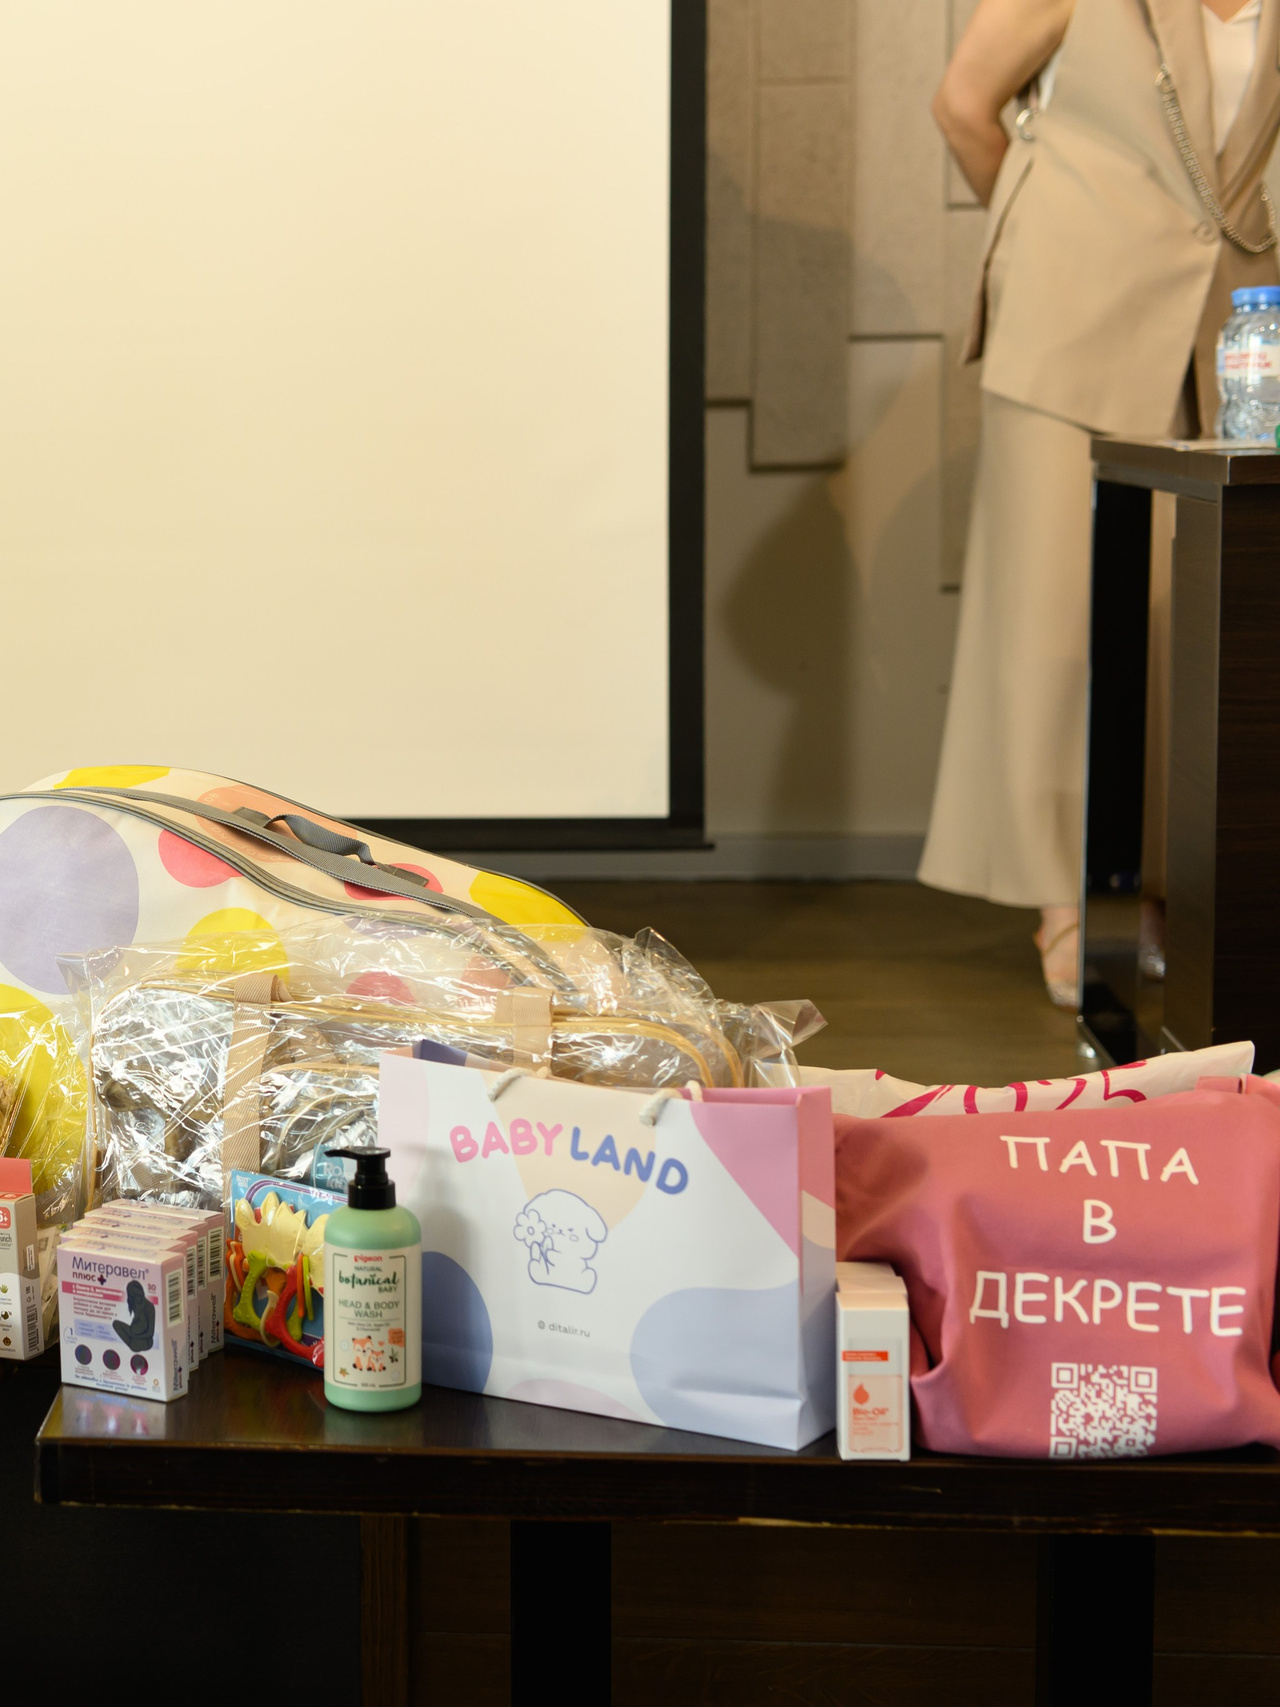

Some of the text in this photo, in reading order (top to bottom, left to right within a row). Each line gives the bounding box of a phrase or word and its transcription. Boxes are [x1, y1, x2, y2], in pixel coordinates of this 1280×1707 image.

[450, 1118, 688, 1195] BABY LAND
[999, 1135, 1199, 1185] ПАПА
[1083, 1199, 1117, 1244] В
[72, 1256, 146, 1280] Митеравел
[72, 1271, 96, 1282] плюс
[147, 1283, 157, 1292] 30
[339, 1270, 397, 1289] botanical
[339, 1299, 400, 1310] HEAD & BODY
[969, 1270, 1247, 1336] ДЕКРЕТЕ
[354, 1310, 383, 1318] WASH
